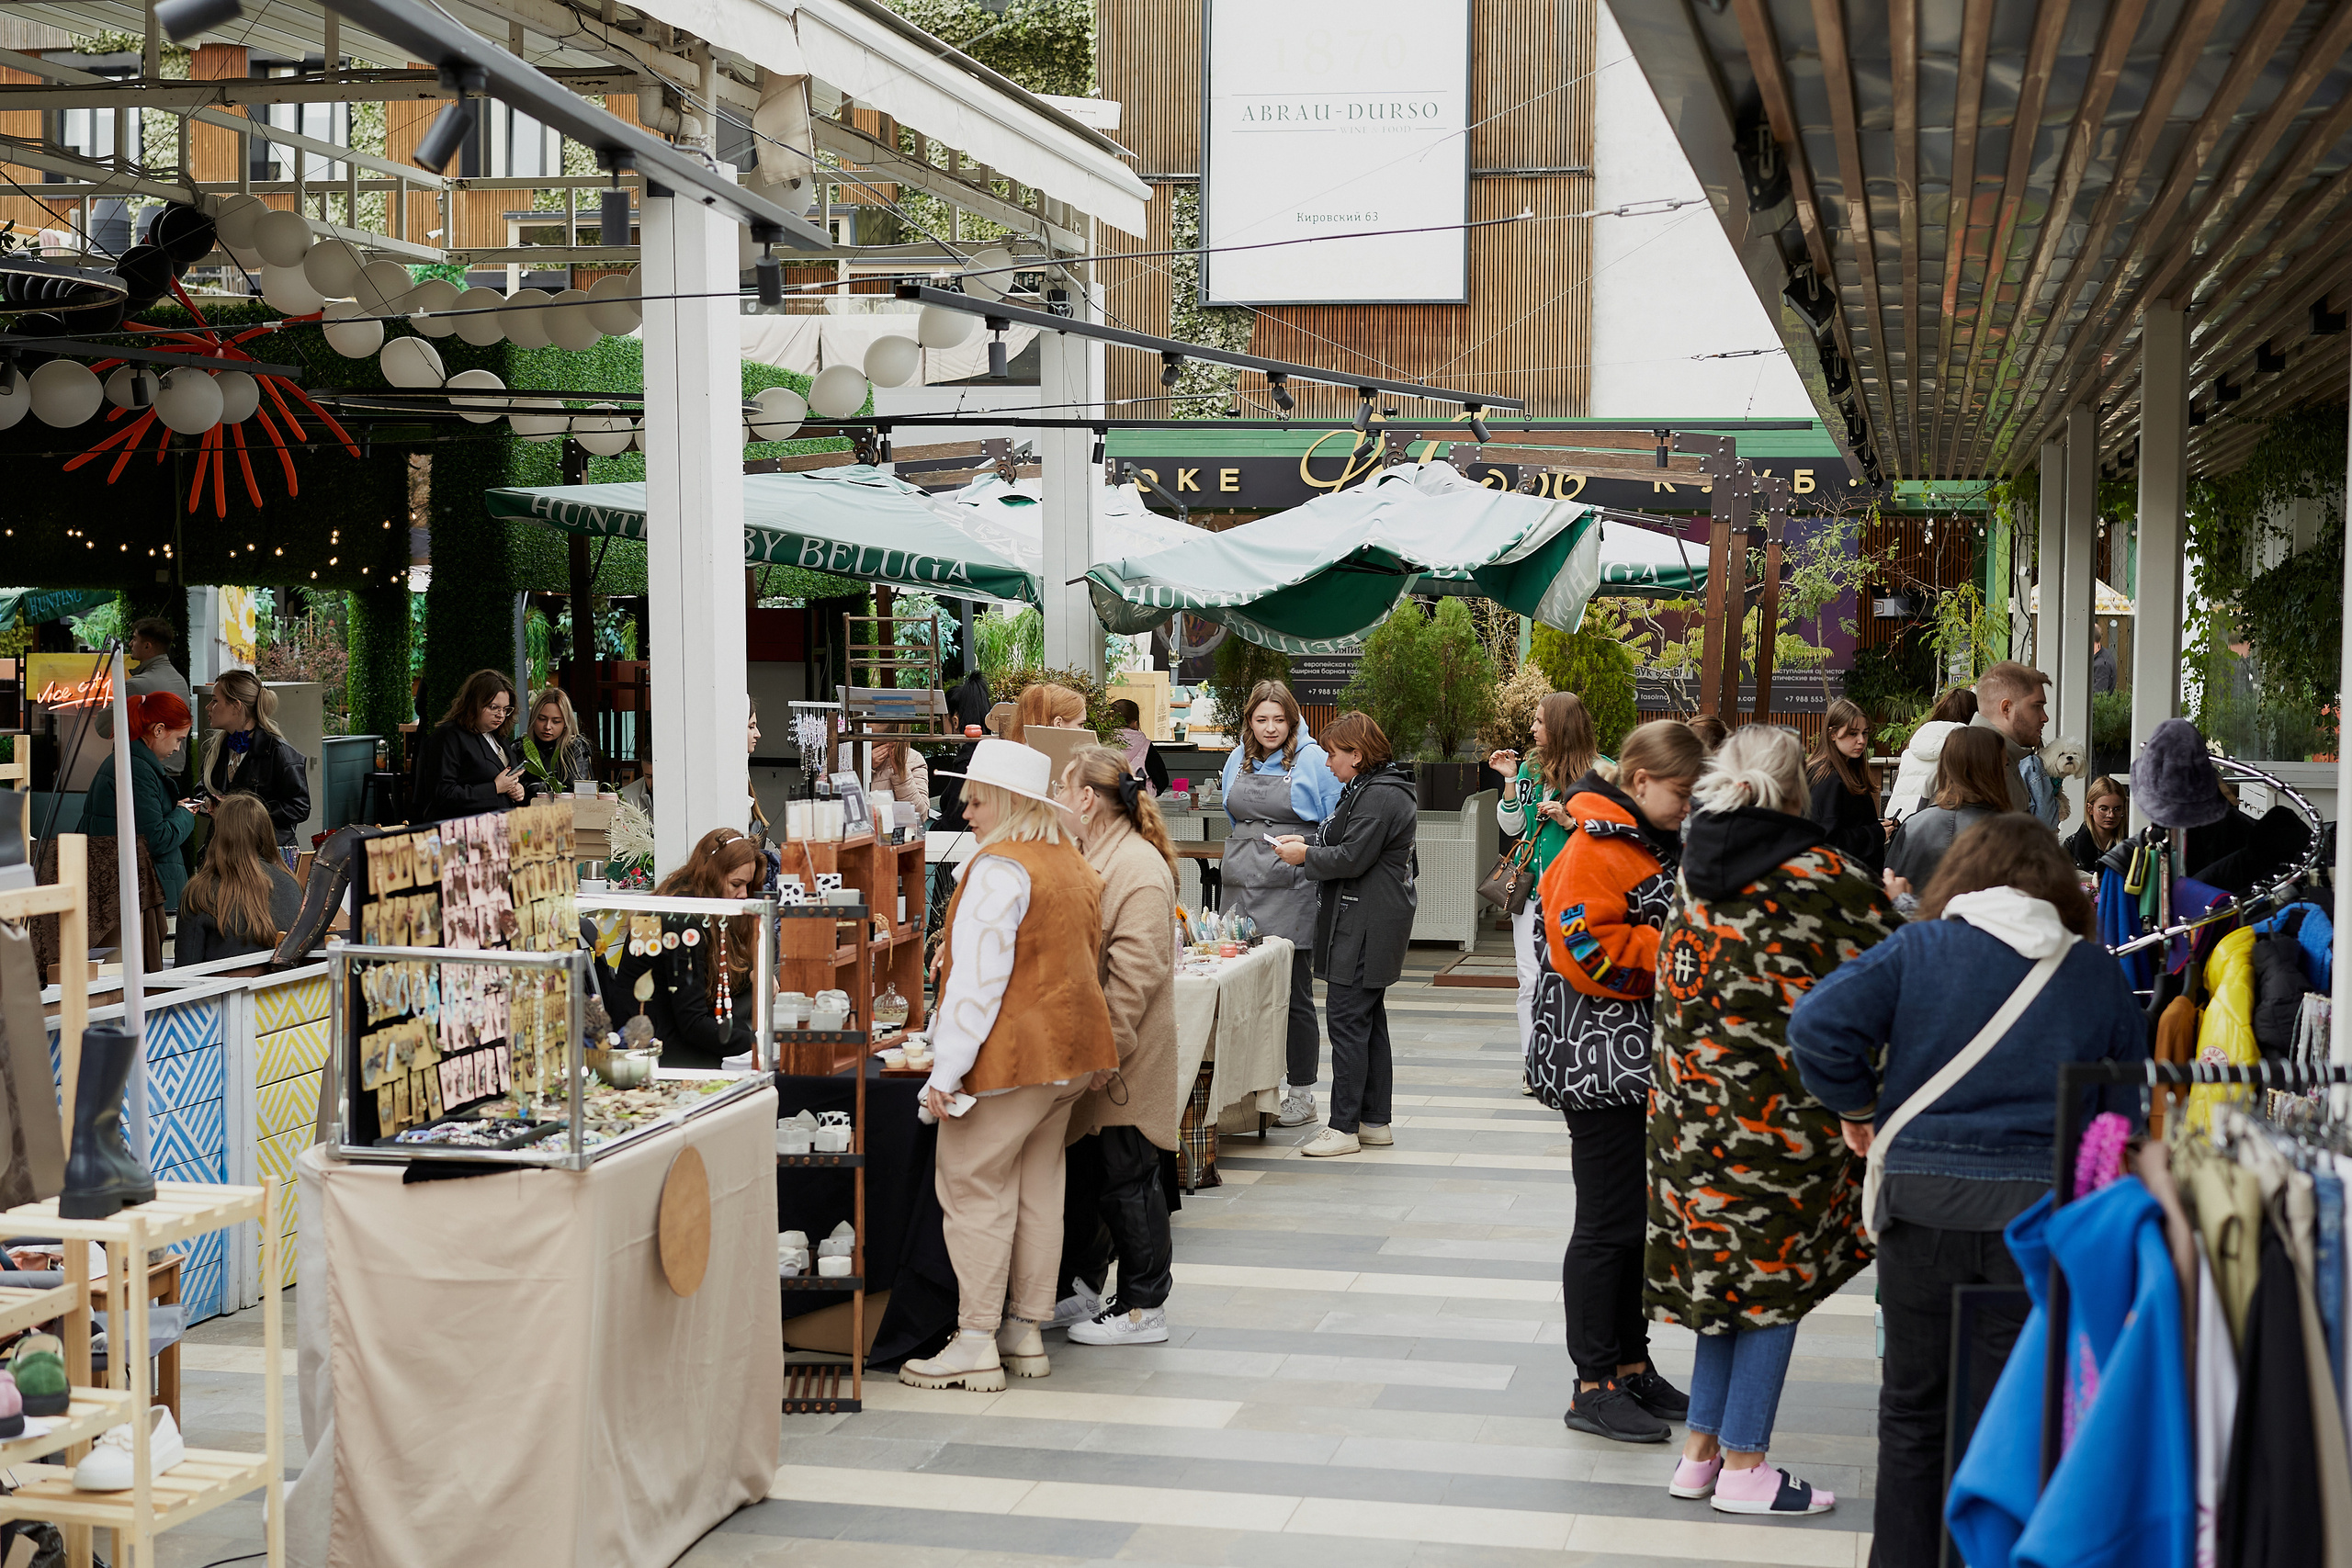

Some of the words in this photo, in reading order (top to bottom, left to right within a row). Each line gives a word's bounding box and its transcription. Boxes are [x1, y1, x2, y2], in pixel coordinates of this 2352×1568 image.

[1272, 28, 1407, 74] 1870
[1241, 101, 1439, 121] ABRAU-DURSO
[1382, 125, 1411, 133] FOOD
[1296, 212, 1362, 224] Кировский
[1365, 211, 1379, 222] 63
[1133, 467, 1240, 492] ОКЕ
[530, 494, 647, 540] HUNTI
[797, 537, 973, 585] BELUGA
[28, 589, 83, 616] HUNTING
[1115, 1314, 1167, 1332] adidas
